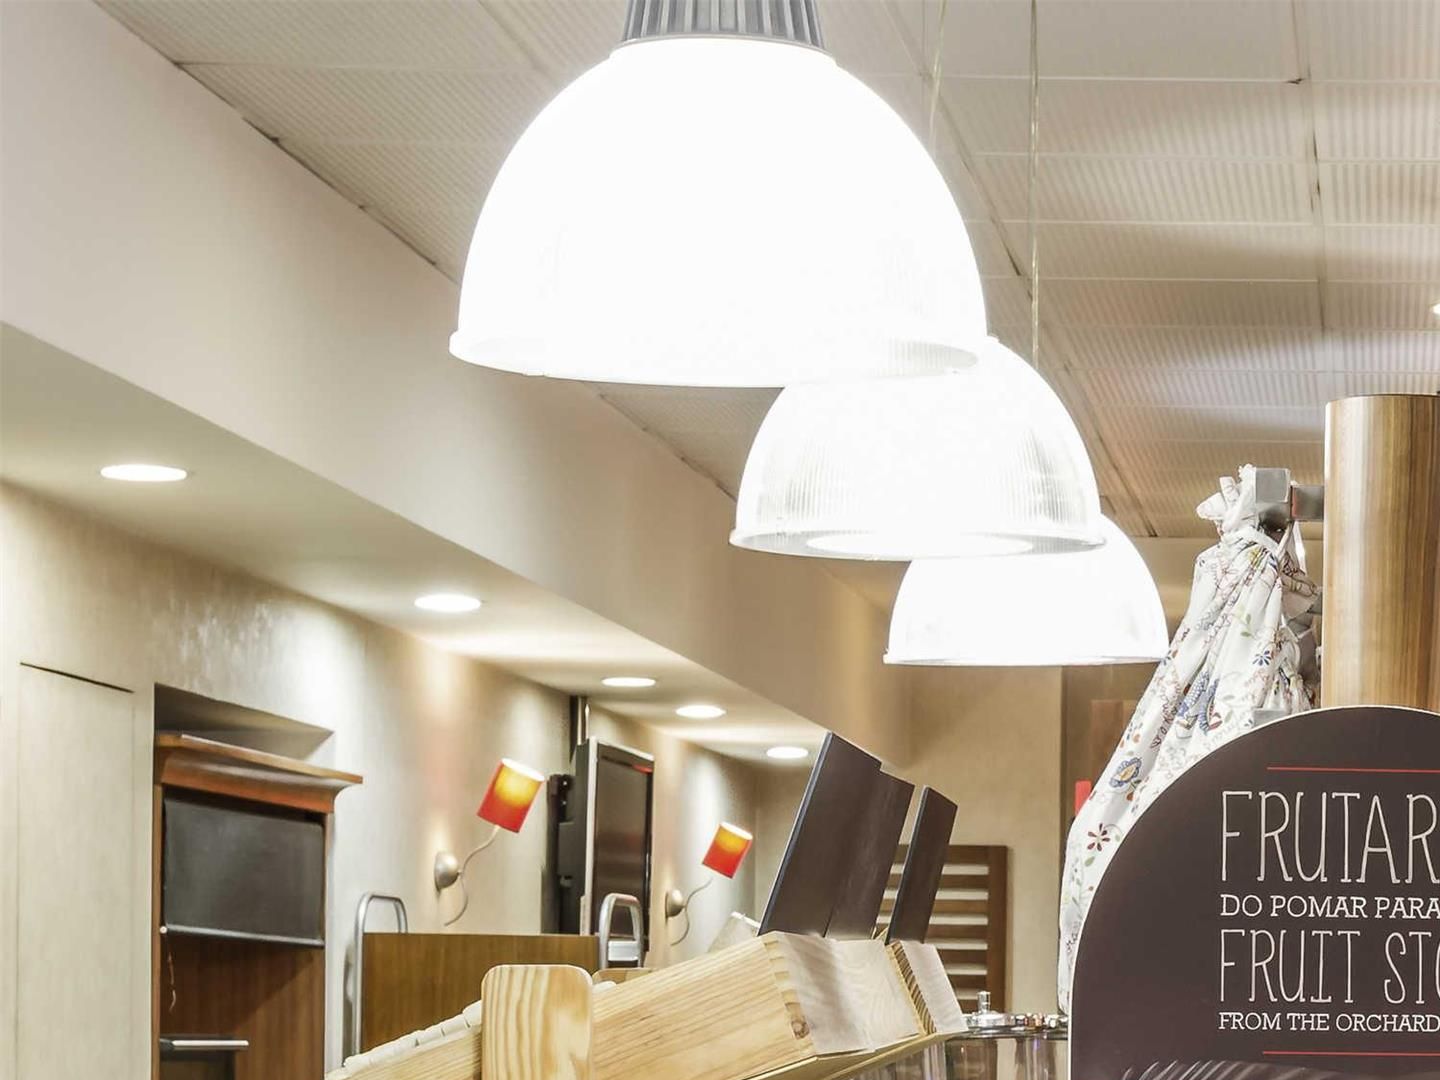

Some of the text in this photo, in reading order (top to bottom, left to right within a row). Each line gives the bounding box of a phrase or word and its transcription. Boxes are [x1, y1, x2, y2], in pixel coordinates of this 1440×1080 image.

[1220, 893, 1263, 917] DO
[1269, 895, 1369, 919] POMAR
[1220, 928, 1361, 1004] FRUIT
[1218, 1011, 1282, 1031] FROM
[1286, 1012, 1330, 1031] THE
[1335, 1013, 1440, 1033] ORCHARD
